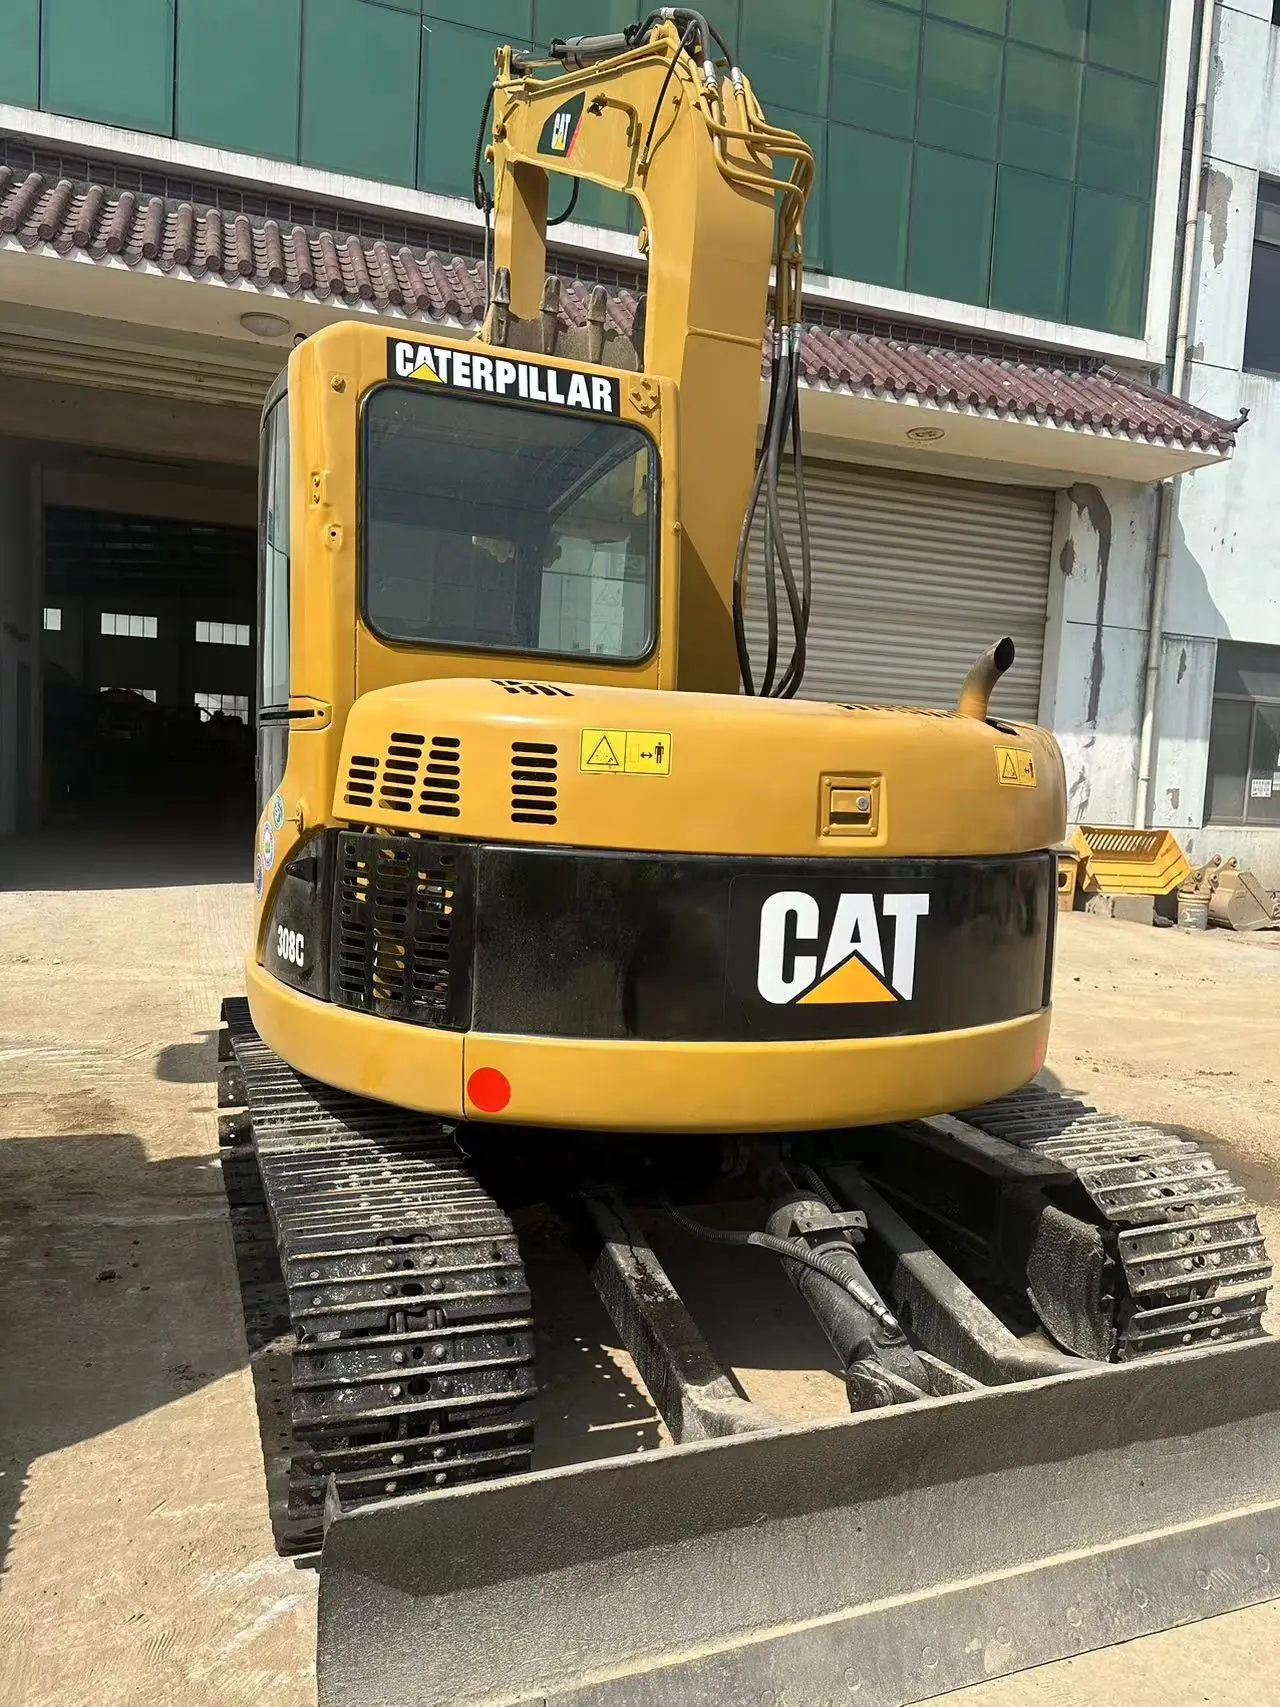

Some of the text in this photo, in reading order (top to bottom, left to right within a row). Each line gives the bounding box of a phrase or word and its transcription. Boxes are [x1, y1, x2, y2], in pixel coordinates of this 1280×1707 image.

[551, 112, 571, 150] CAT
[395, 342, 612, 412] CATERPILLAR
[277, 924, 305, 968] 308C
[757, 891, 930, 1004] CAT
